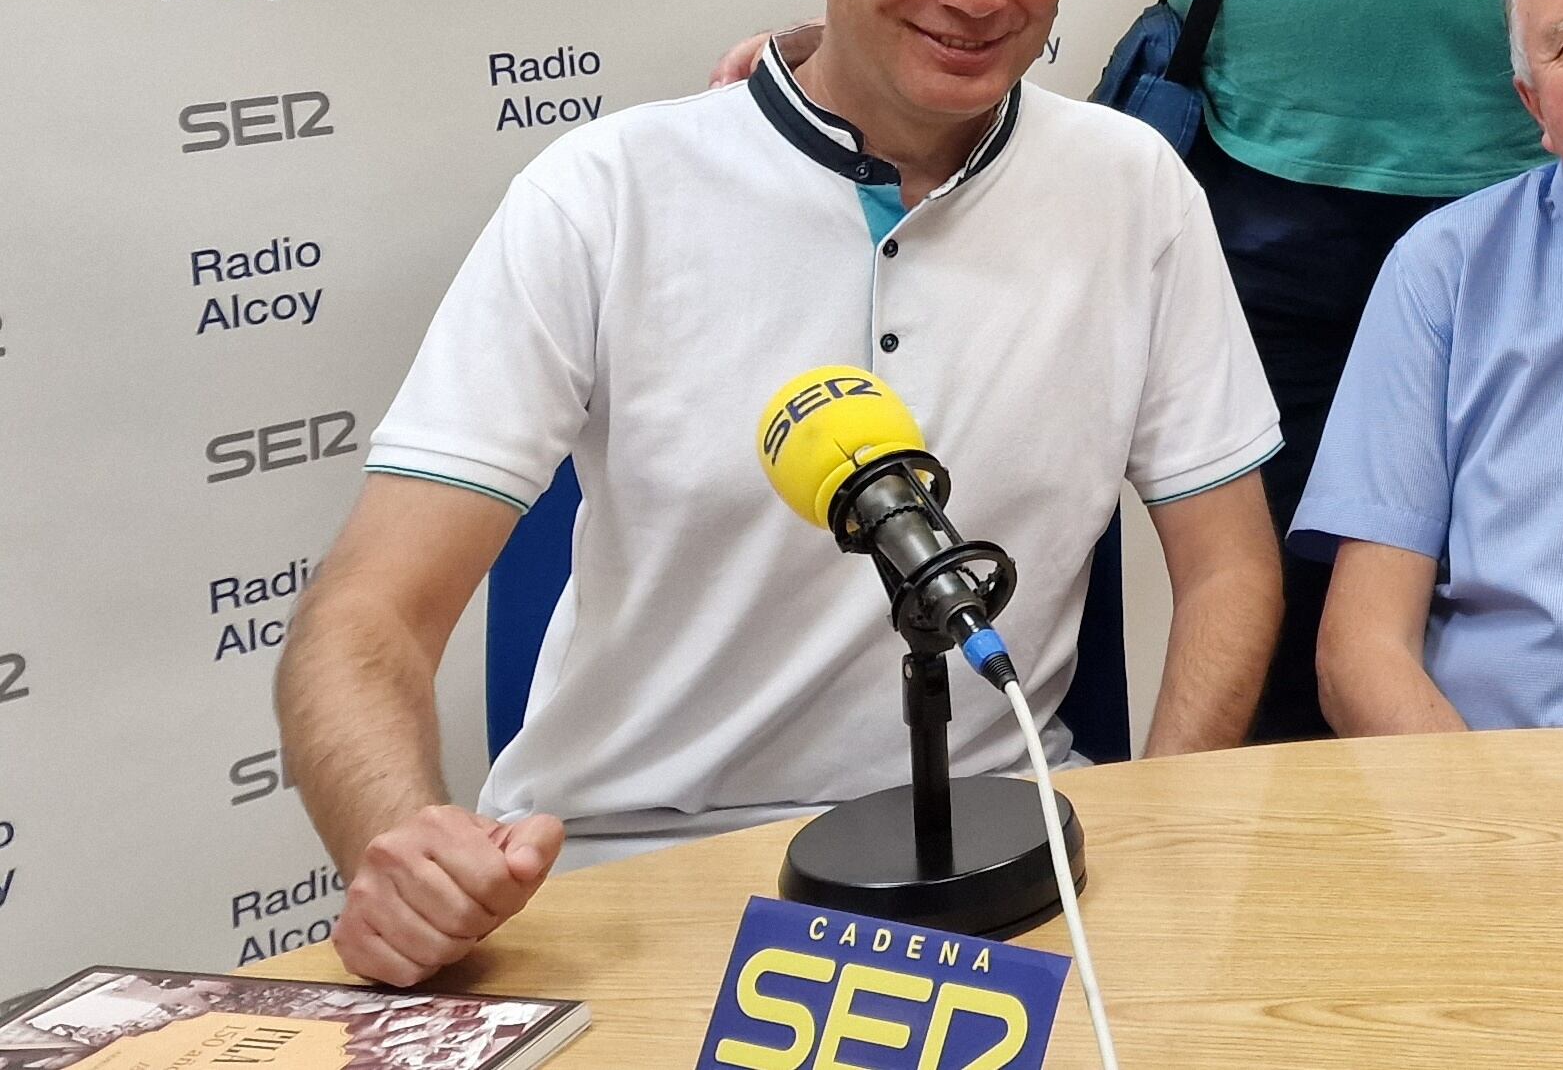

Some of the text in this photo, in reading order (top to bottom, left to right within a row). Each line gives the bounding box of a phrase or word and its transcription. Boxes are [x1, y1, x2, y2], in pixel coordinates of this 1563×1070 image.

[489, 45, 601, 87] Radio
[179, 91, 334, 153] SER
[496, 95, 603, 132] Alcoy
[192, 239, 320, 285] Radio
[197, 289, 322, 334] Alcoy
[206, 411, 358, 483] SER
[763, 377, 882, 466] SER
[210, 557, 309, 615] Radi
[214, 617, 286, 662] Alc
[237, 915, 338, 967] Alco
[808, 916, 991, 973] CADENA
